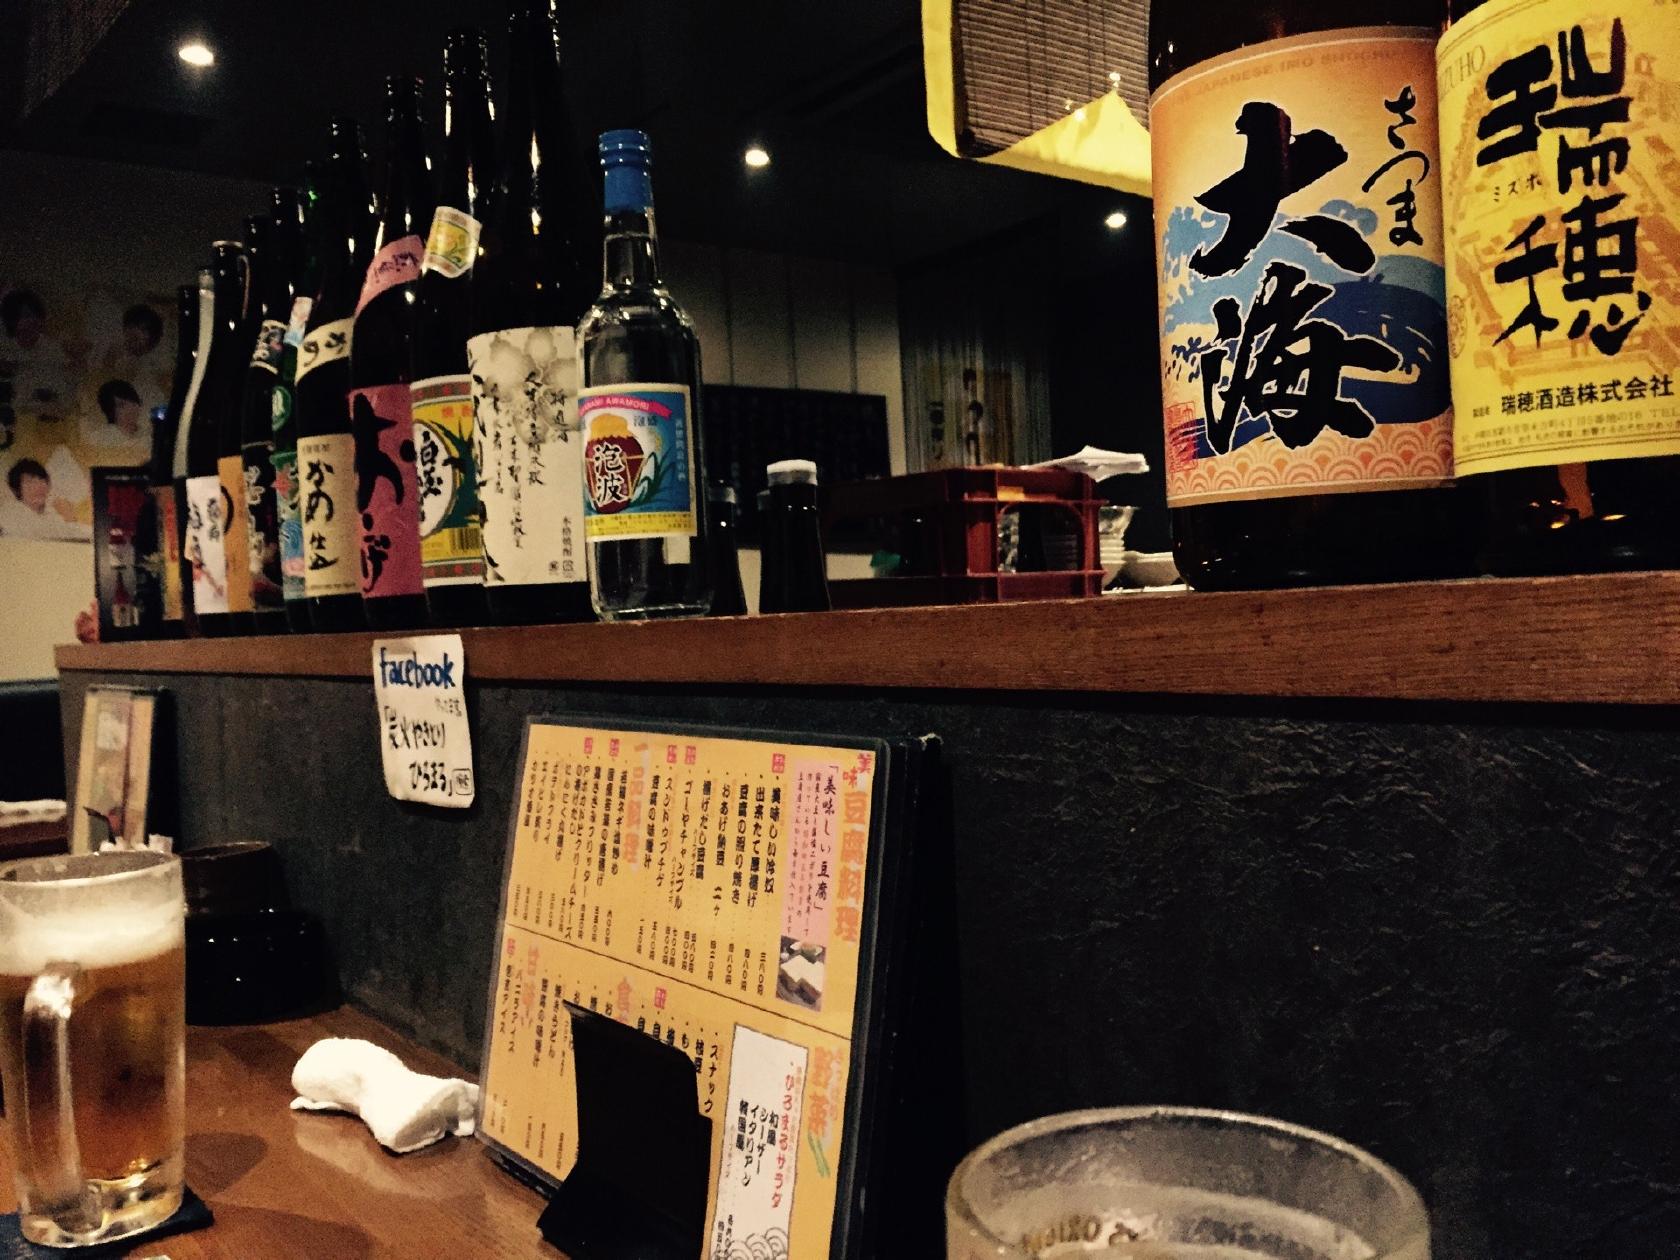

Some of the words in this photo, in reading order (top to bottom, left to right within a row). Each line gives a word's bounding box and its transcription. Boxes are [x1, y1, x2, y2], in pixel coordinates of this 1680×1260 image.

[1362, 85, 1430, 247] さつま
[1476, 17, 1653, 356] 瑞穂
[1493, 172, 1543, 203] ミズホ
[1188, 101, 1402, 456] 大海
[1501, 373, 1675, 416] 瑞穂酒造株式会社
[594, 443, 622, 505] 泡波
[379, 647, 455, 689] facebook
[729, 783, 750, 904] 豆腐の照り焼き
[745, 786, 767, 907] 出来たて厚揚げ
[763, 787, 783, 893] 美味しい冷奴
[741, 1103, 759, 1187] イタリアン
